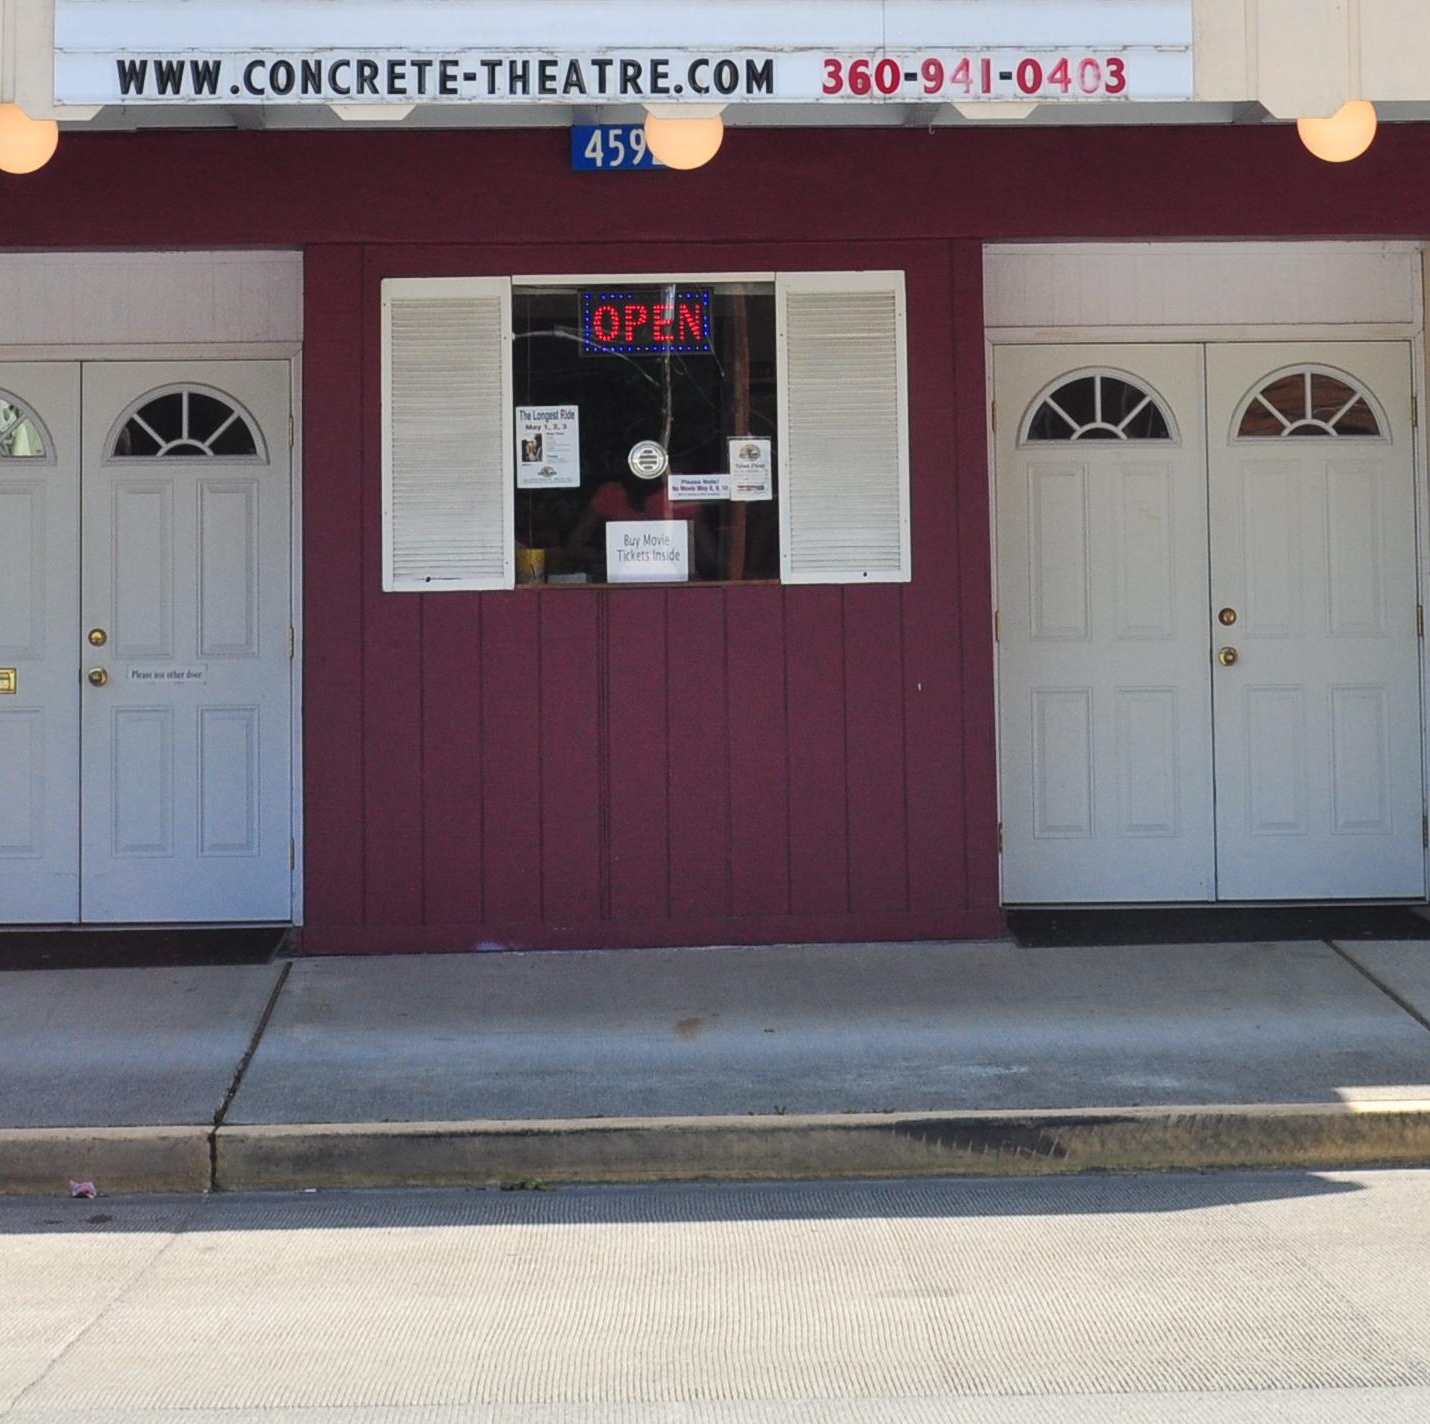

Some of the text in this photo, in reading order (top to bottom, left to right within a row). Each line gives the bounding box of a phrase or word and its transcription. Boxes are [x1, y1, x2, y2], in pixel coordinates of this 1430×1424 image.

[116, 59, 1126, 96] WWW.CONCRETE-THEATRE.COM 360-941-0403
[584, 128, 667, 167] 459
[593, 304, 702, 342] OPEN
[533, 409, 559, 423] Longest
[560, 409, 575, 420] Ride
[624, 533, 671, 548] Buy Movie
[617, 547, 680, 562] Tickets Inside
